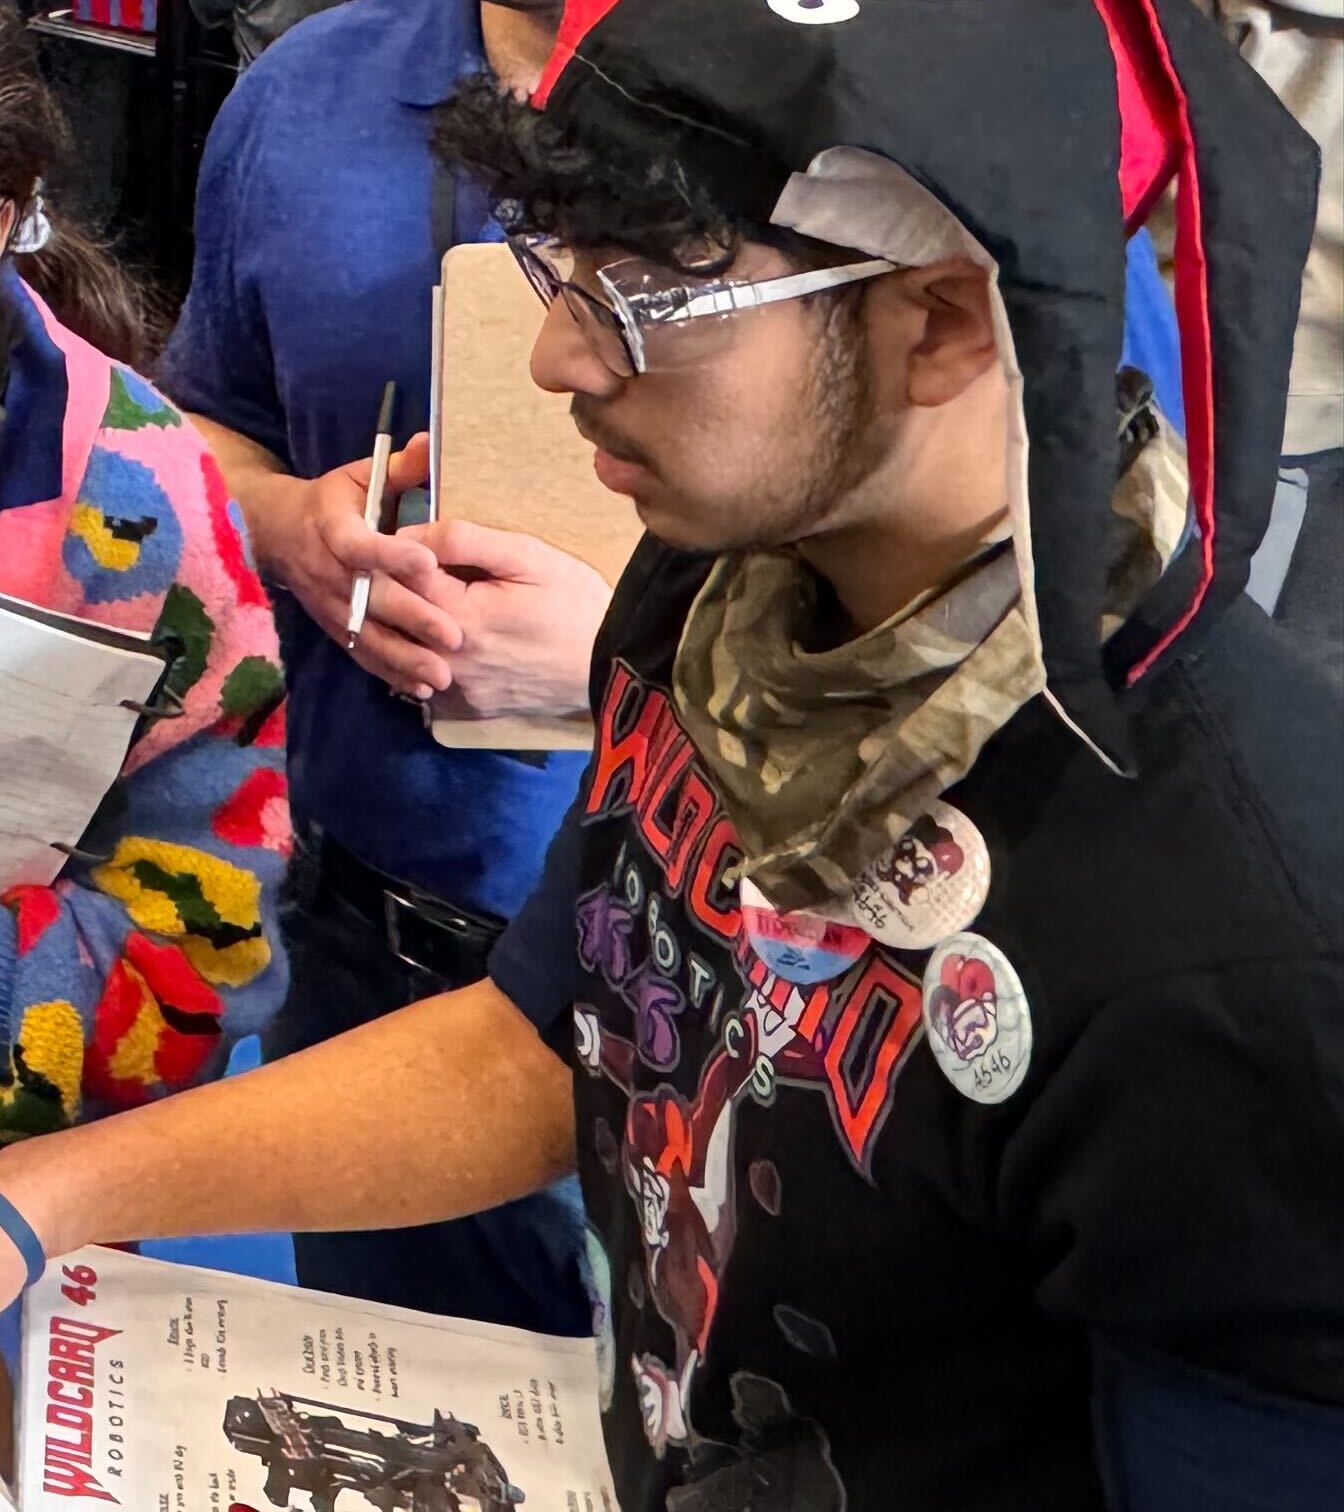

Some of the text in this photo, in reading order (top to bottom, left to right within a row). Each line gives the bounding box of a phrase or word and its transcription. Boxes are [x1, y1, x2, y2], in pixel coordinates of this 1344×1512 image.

[615, 840, 776, 1104] OBOTICS
[43, 1264, 124, 1506] WILDCARD 46
[107, 1359, 125, 1478] ROBOTICS
